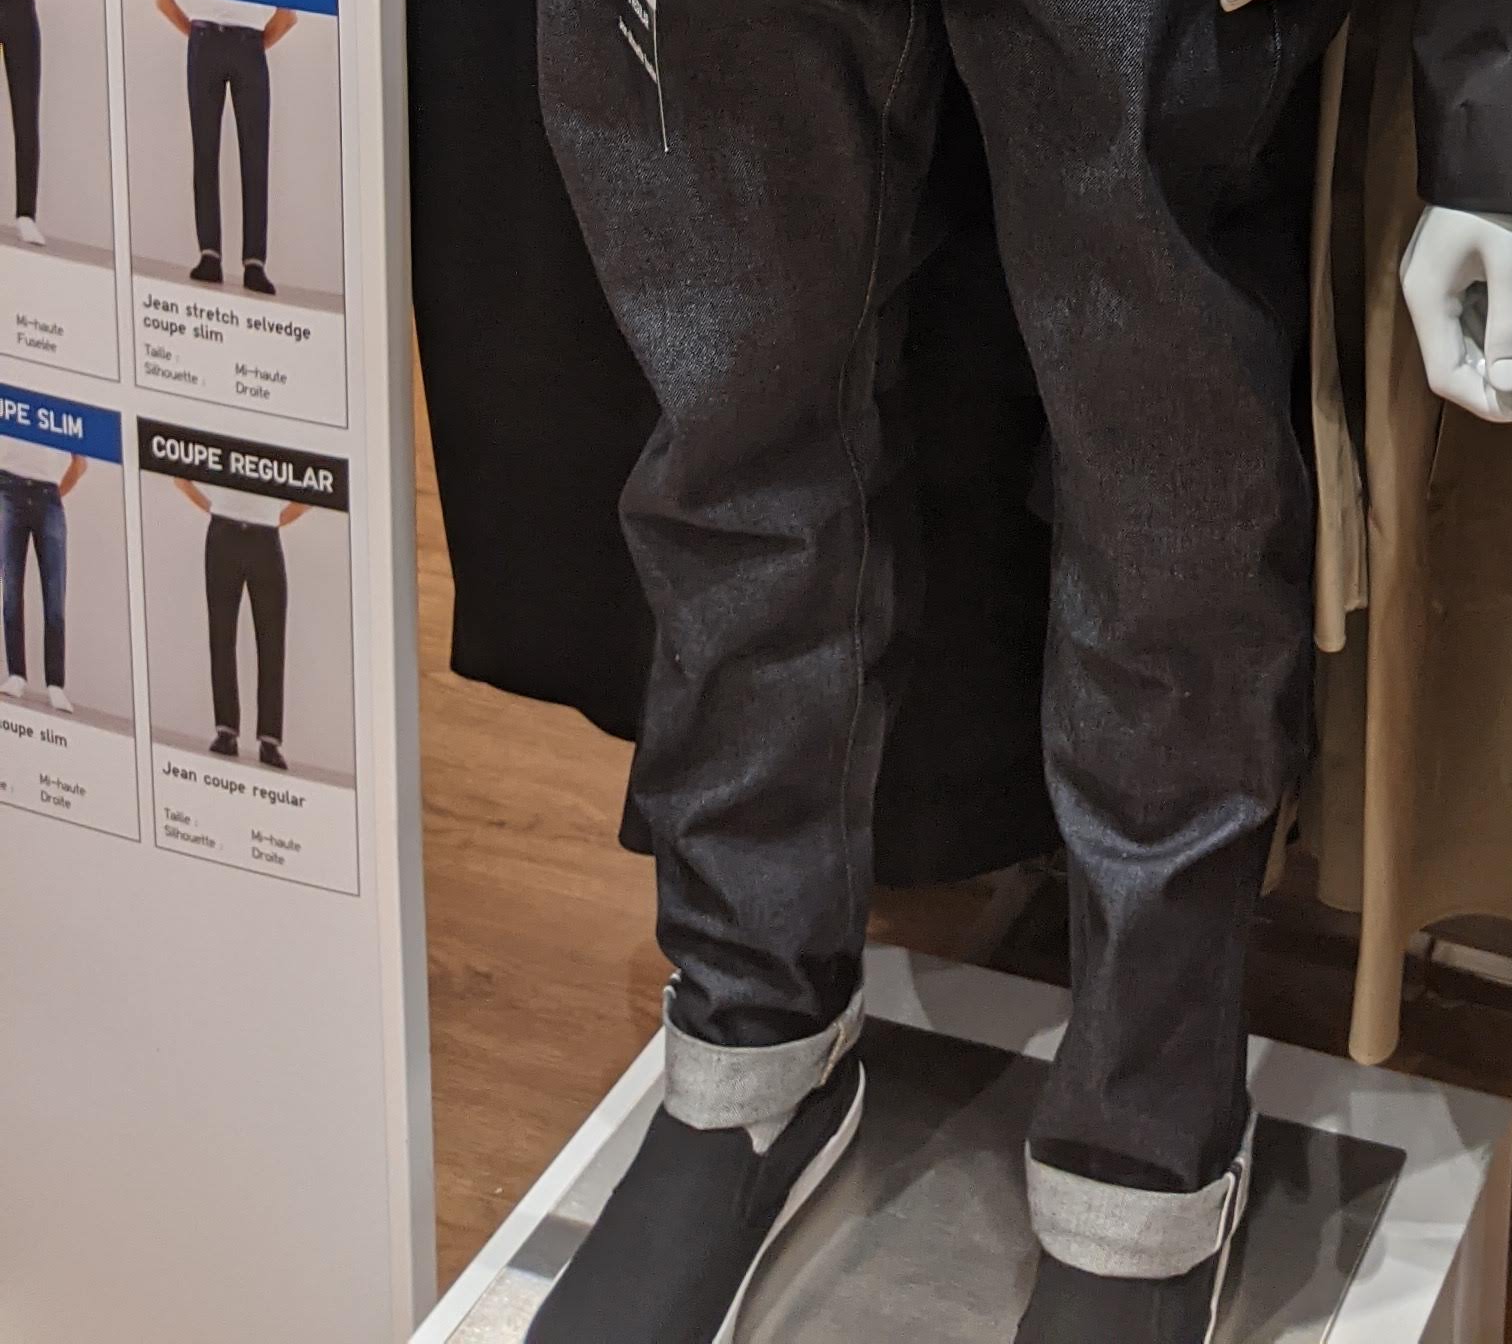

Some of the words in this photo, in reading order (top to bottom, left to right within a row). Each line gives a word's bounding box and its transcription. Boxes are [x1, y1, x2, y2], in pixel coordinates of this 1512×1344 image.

[16, 313, 65, 338] Mi-haute
[143, 294, 180, 315] Jean
[186, 301, 240, 327] stretch
[246, 315, 312, 342] selvedge
[143, 315, 188, 338] coupe
[193, 324, 225, 343] slim
[144, 343, 173, 362] Taille
[143, 362, 199, 386] Silhouette
[235, 362, 288, 385] Mi-haute
[235, 382, 271, 401] Droite
[37, 408, 83, 440] SLIM
[151, 434, 223, 472] COUPE
[229, 451, 334, 494] REGULAR
[40, 725, 69, 748] slim
[39, 773, 86, 797] Mi-haute
[162, 761, 197, 783] Jean
[203, 772, 246, 795] coupe
[253, 785, 306, 809] regular
[40, 790, 72, 810] Droite
[164, 807, 191, 826] Taille
[251, 828, 302, 853] Mi-haute
[251, 846, 286, 866] Droite
